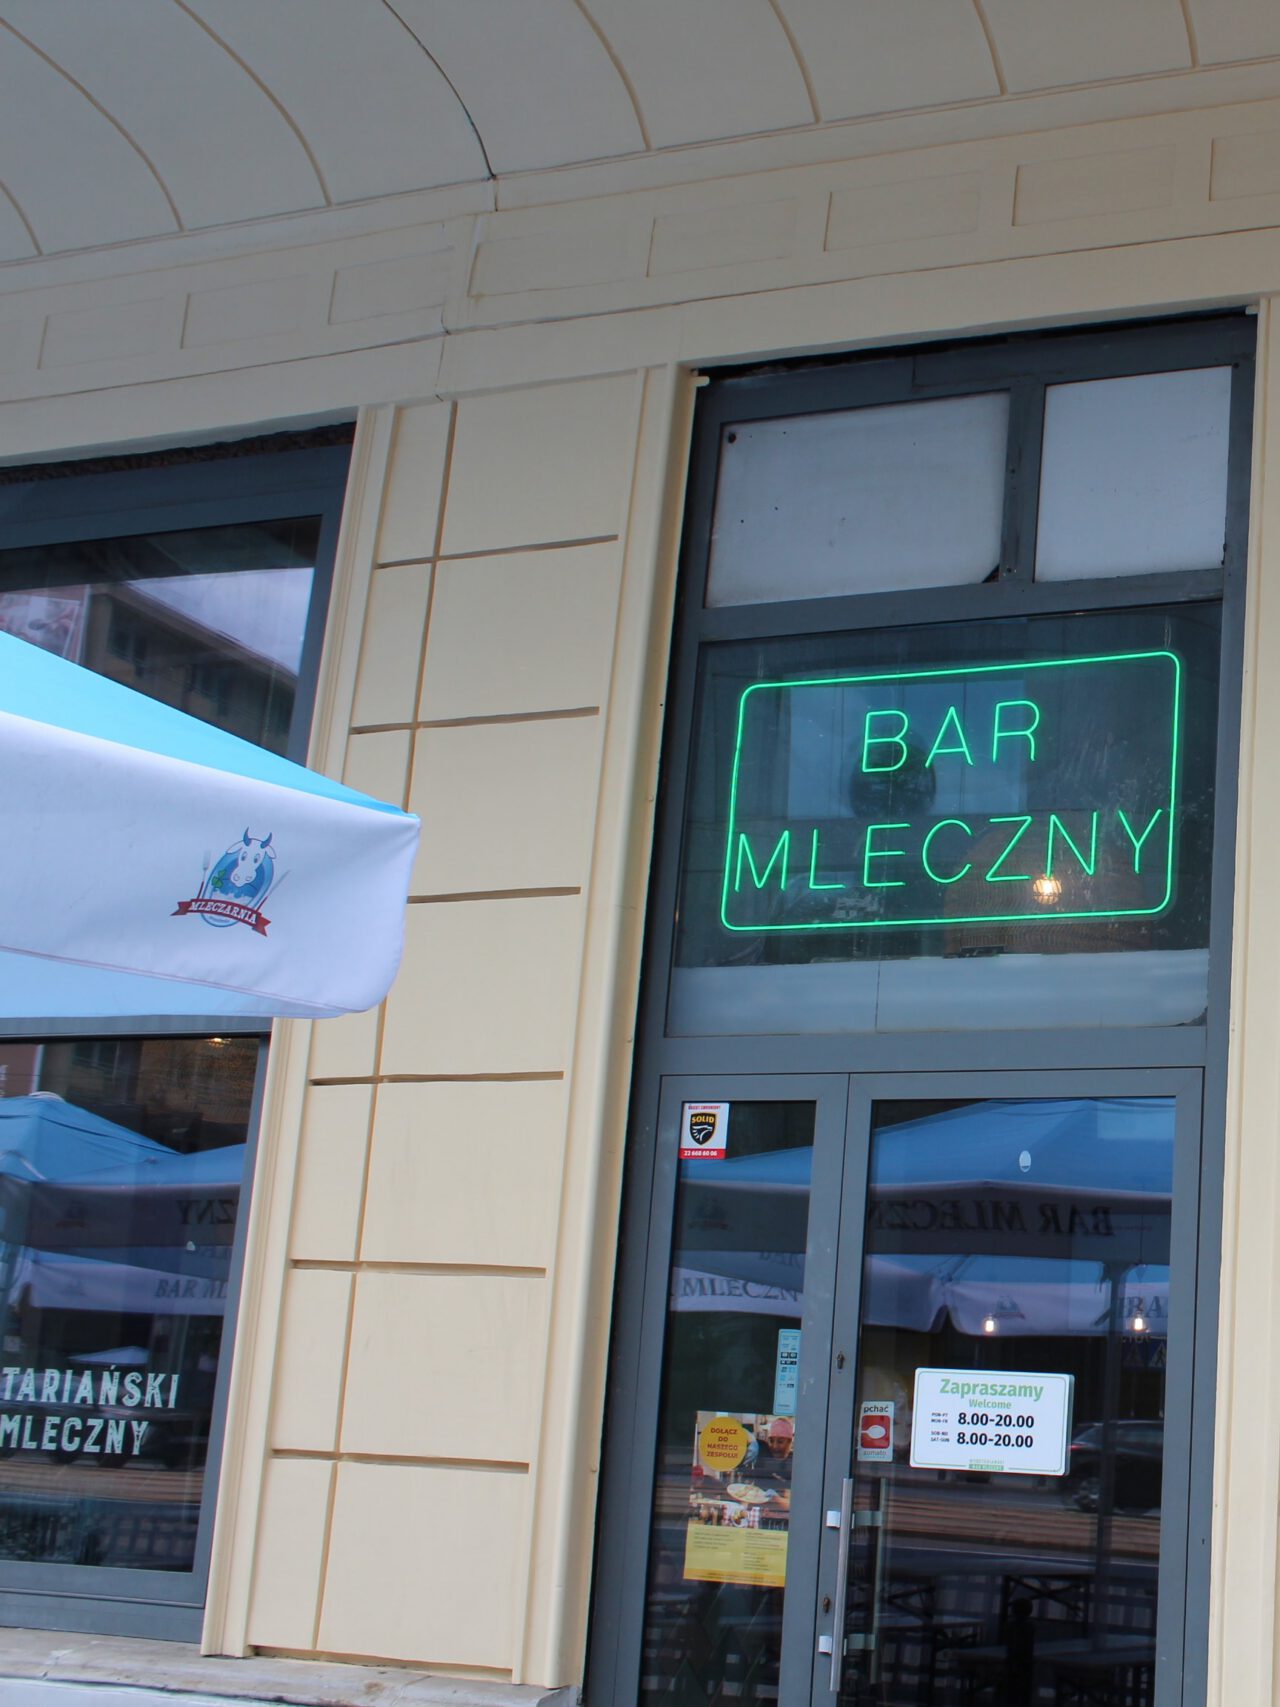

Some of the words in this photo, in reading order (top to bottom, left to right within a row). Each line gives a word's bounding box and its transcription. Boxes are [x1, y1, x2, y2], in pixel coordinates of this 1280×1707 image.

[862, 700, 1040, 773] BAR
[735, 809, 1162, 892] MLECZNY
[188, 901, 257, 924] MLECZARNIA
[692, 1115, 714, 1123] SOLID
[154, 1278, 199, 1299] BAR
[2, 1365, 180, 1408] TARIAŃSKI
[940, 1379, 1044, 1402] Zapraszamy
[863, 1404, 889, 1414] pchać
[969, 1399, 1012, 1410] Welcome
[958, 1412, 1035, 1428] 8.00-20.00
[0, 1414, 149, 1455] MLECZNY
[957, 1432, 1034, 1448] 8.00-20.00
